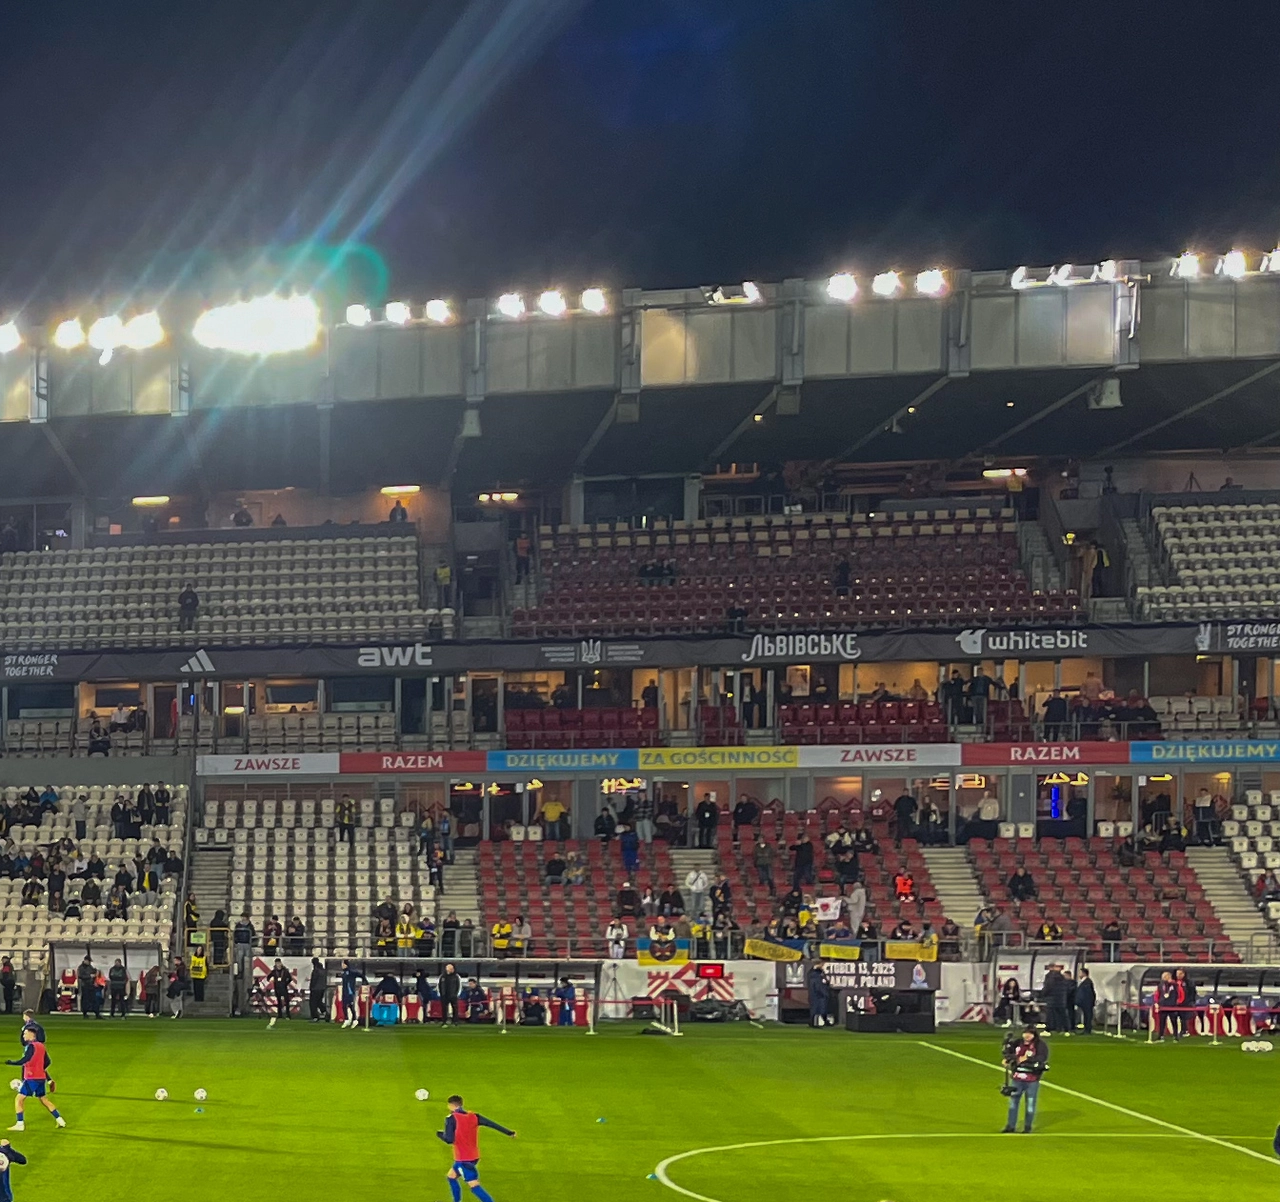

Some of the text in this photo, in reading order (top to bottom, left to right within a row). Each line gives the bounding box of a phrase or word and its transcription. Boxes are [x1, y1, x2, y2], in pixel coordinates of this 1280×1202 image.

[987, 628, 1088, 651] whitebit
[4, 653, 58, 665] STRONGER
[357, 642, 433, 667] awt
[4, 665, 54, 677] TOGETHER
[642, 746, 796, 766] ZA GOŚCINNOŚĆ
[841, 749, 917, 763] ZAWSZE
[1010, 745, 1080, 761] RAZEM
[1152, 744, 1278, 761] DZIĘKUJEMY
[233, 757, 301, 771] ZAWSZE
[382, 755, 444, 769] RAZEM
[506, 752, 619, 769] DZIĘKUJEMY
[872, 962, 895, 974] 2025
[860, 976, 895, 988] POLAND
